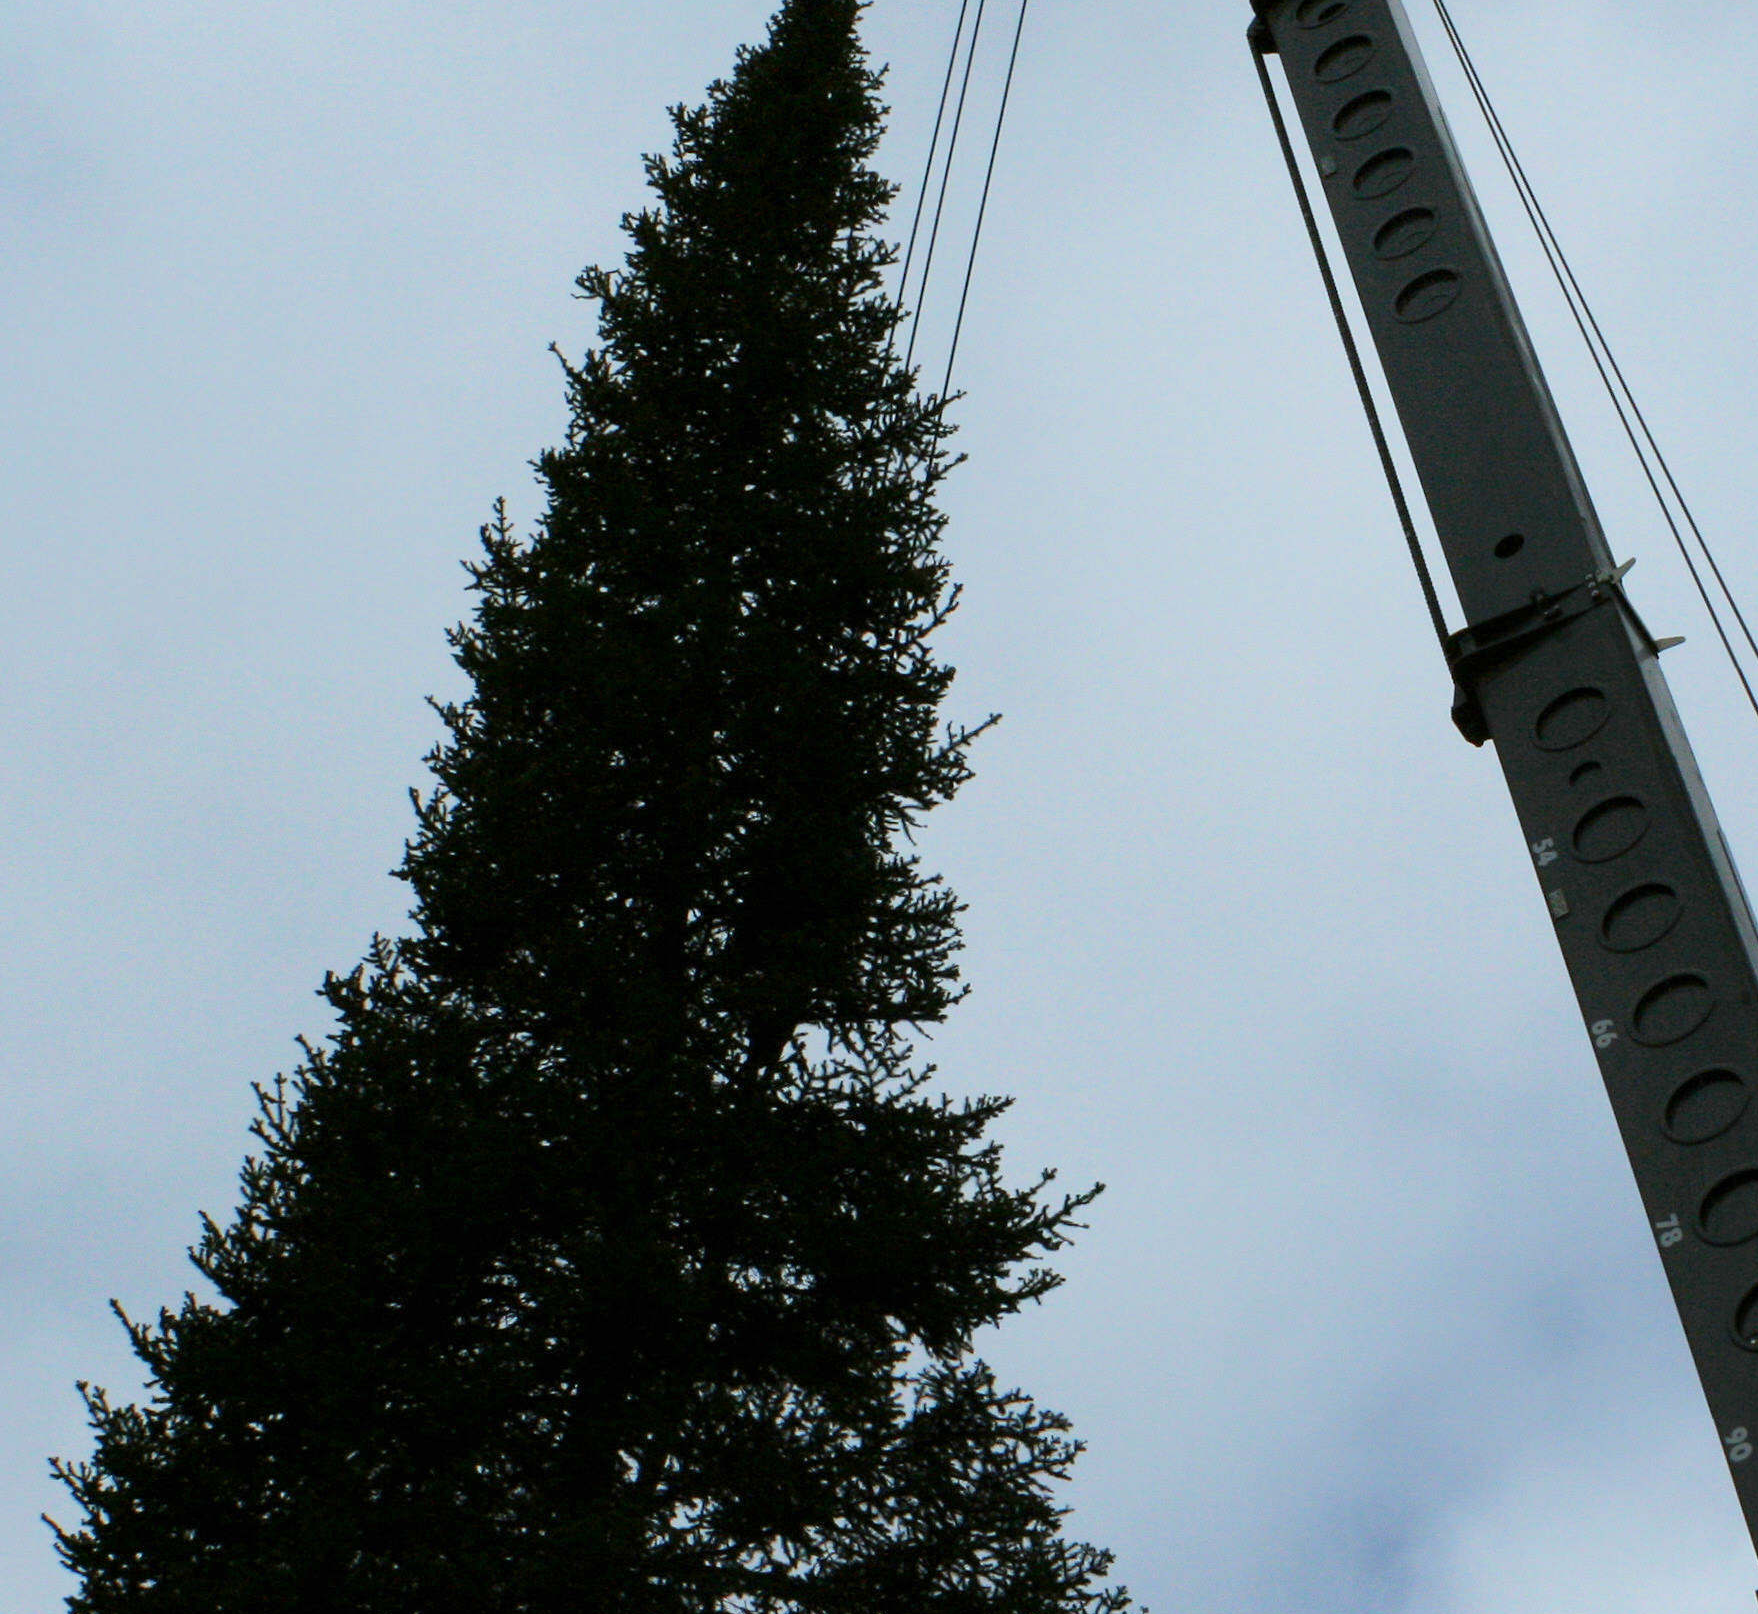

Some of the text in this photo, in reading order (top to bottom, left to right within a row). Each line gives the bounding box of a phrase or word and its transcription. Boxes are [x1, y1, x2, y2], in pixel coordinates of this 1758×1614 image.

[1532, 836, 1558, 867] 54
[1592, 1019, 1618, 1049] 66
[1655, 1212, 1683, 1248] 78
[1724, 1426, 1753, 1464] 90
